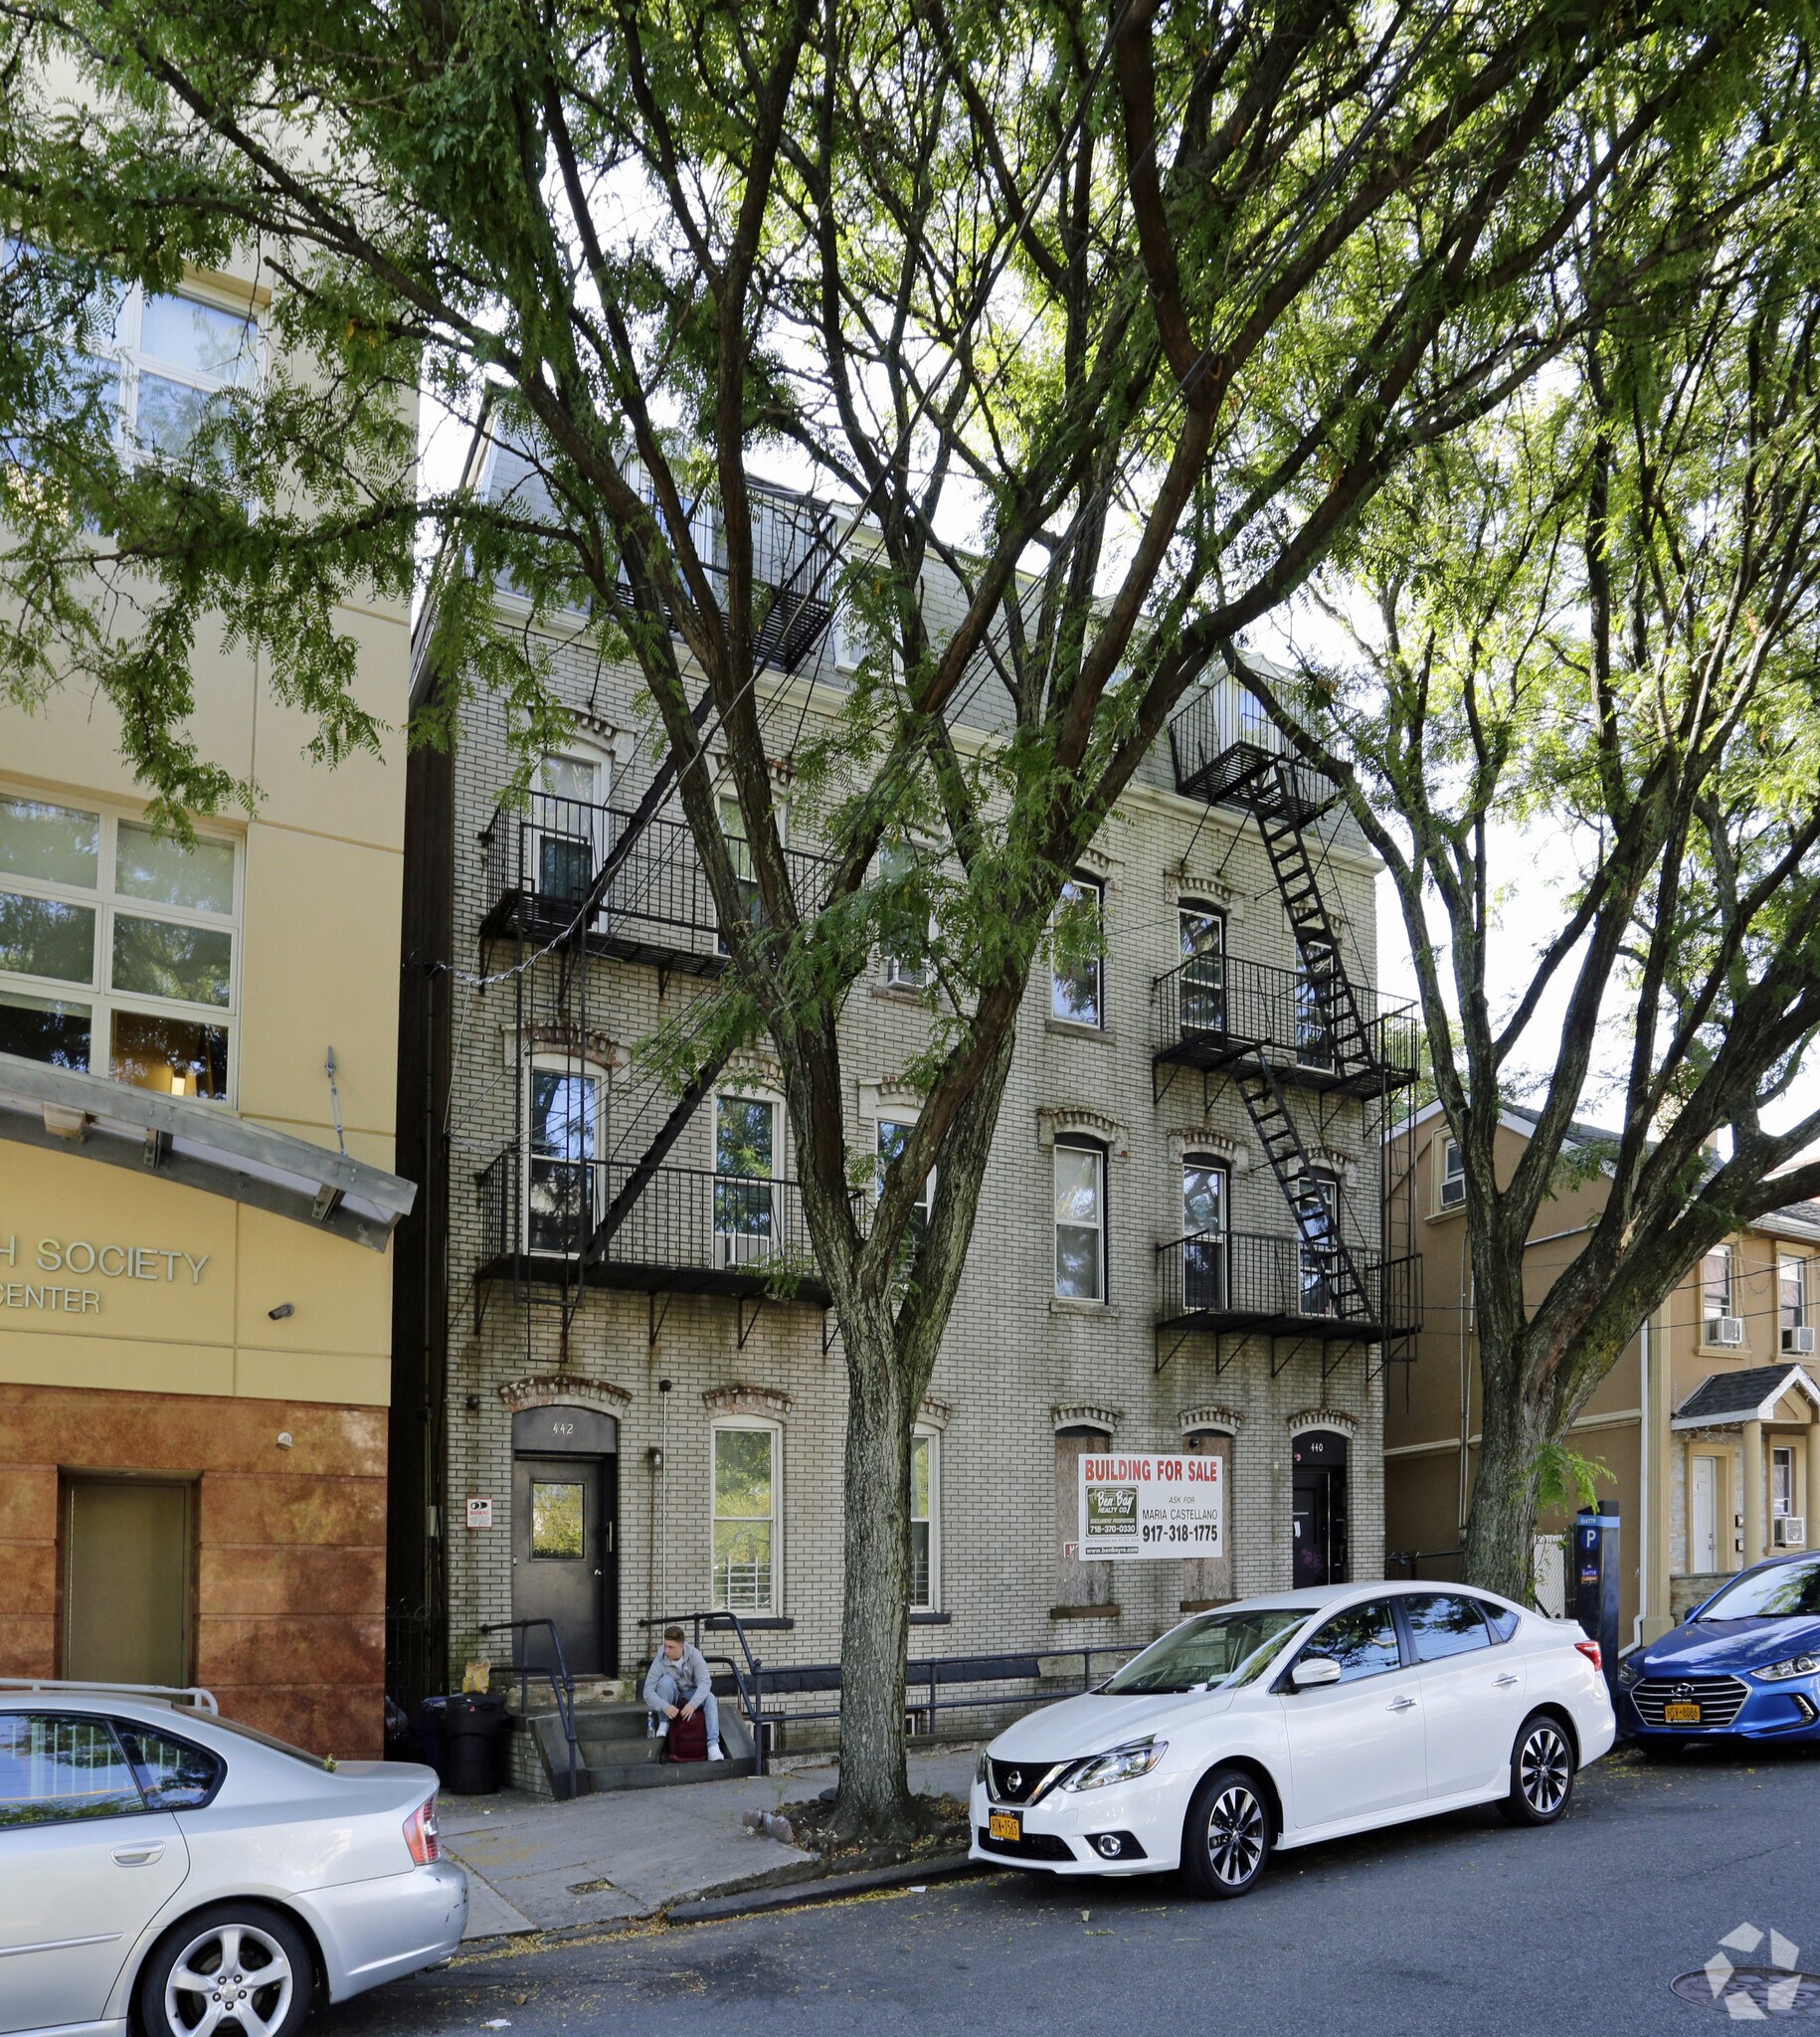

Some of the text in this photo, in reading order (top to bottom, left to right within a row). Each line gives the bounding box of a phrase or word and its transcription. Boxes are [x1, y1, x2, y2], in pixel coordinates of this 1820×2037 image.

[36, 1237, 210, 1285] SOCIETY
[0, 1282, 100, 1314] ENTER
[552, 1423, 574, 1435] 442
[1311, 1442, 1324, 1452] 440
[1085, 1459, 1217, 1482] BUILDING FOR SALE
[1142, 1509, 1218, 1521] MARIA CASTELLANO
[1142, 1524, 1218, 1543] 917-318-1775
[1586, 1530, 1596, 1548] P
